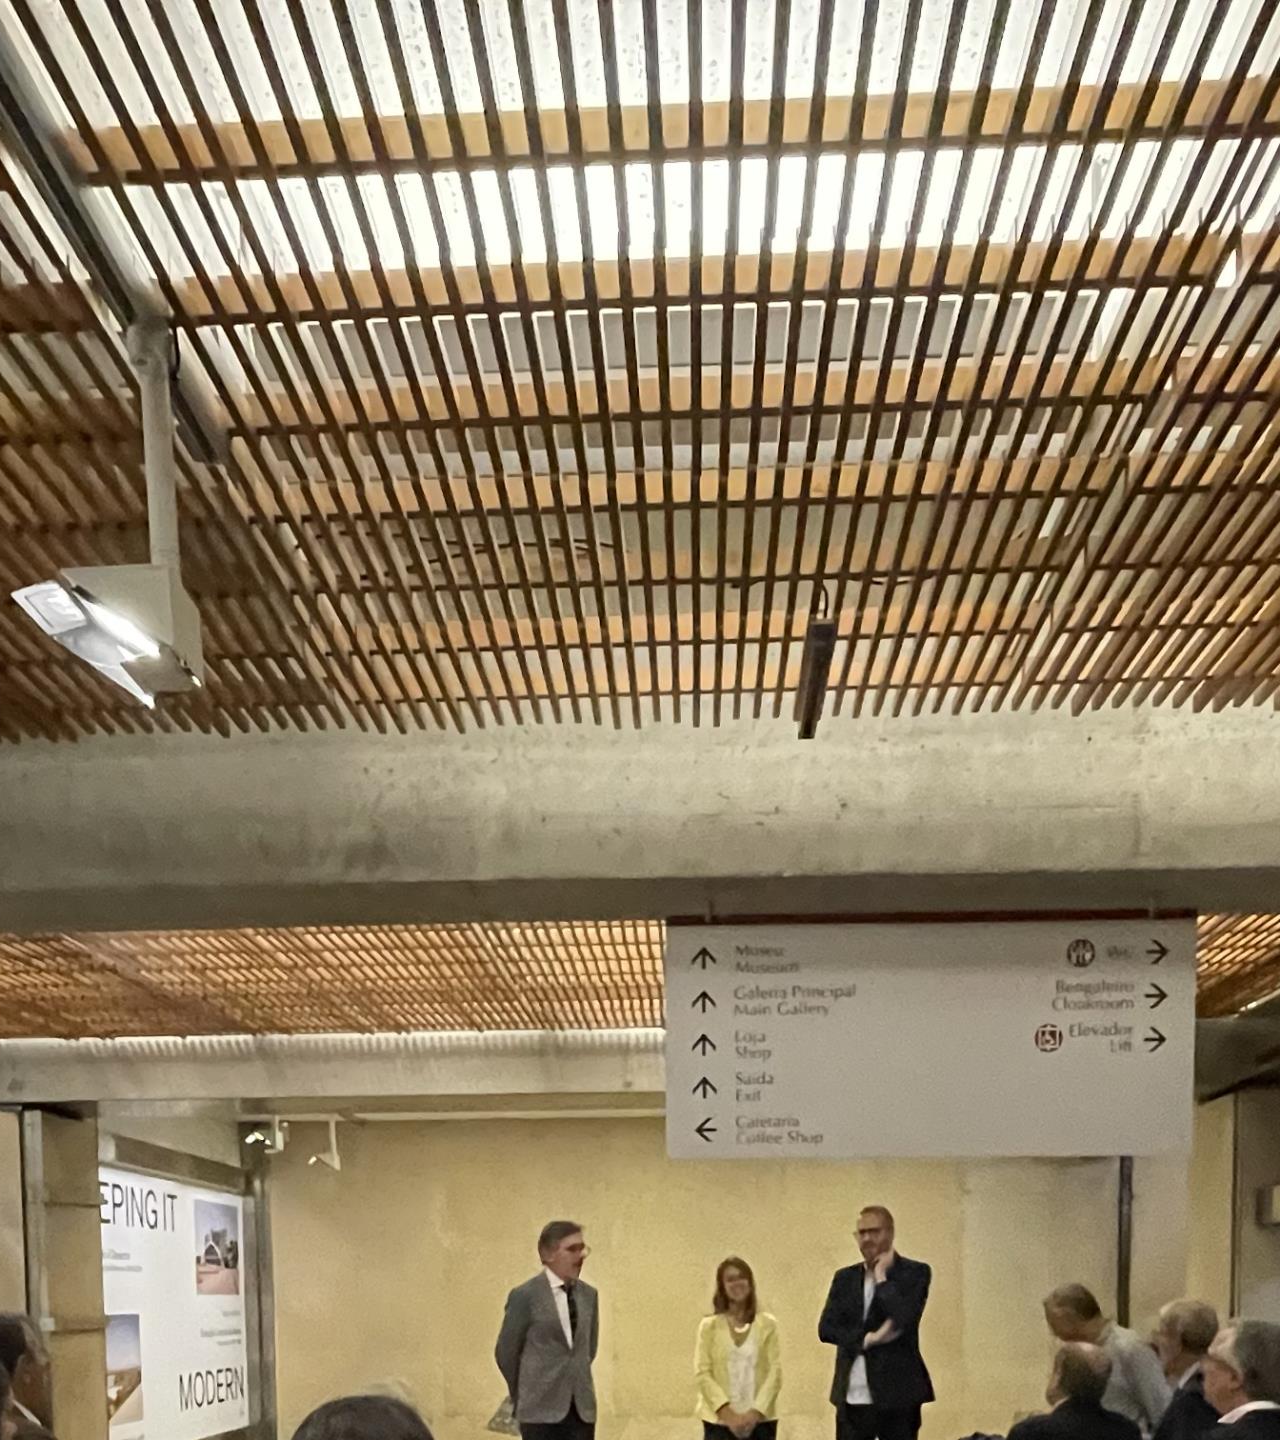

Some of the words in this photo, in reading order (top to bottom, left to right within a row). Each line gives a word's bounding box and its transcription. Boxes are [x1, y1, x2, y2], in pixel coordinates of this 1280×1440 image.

[735, 961, 800, 974] Museum
[734, 984, 788, 1000] Galeria
[791, 983, 856, 1001] Principal
[733, 1003, 771, 1016] Main
[776, 1001, 829, 1017] Gallery
[1068, 1022, 1133, 1038] Elevador
[735, 1046, 772, 1062] Shop
[786, 1129, 824, 1146] Shop
[162, 1192, 178, 1233] IT
[179, 1365, 245, 1413] MODERN
